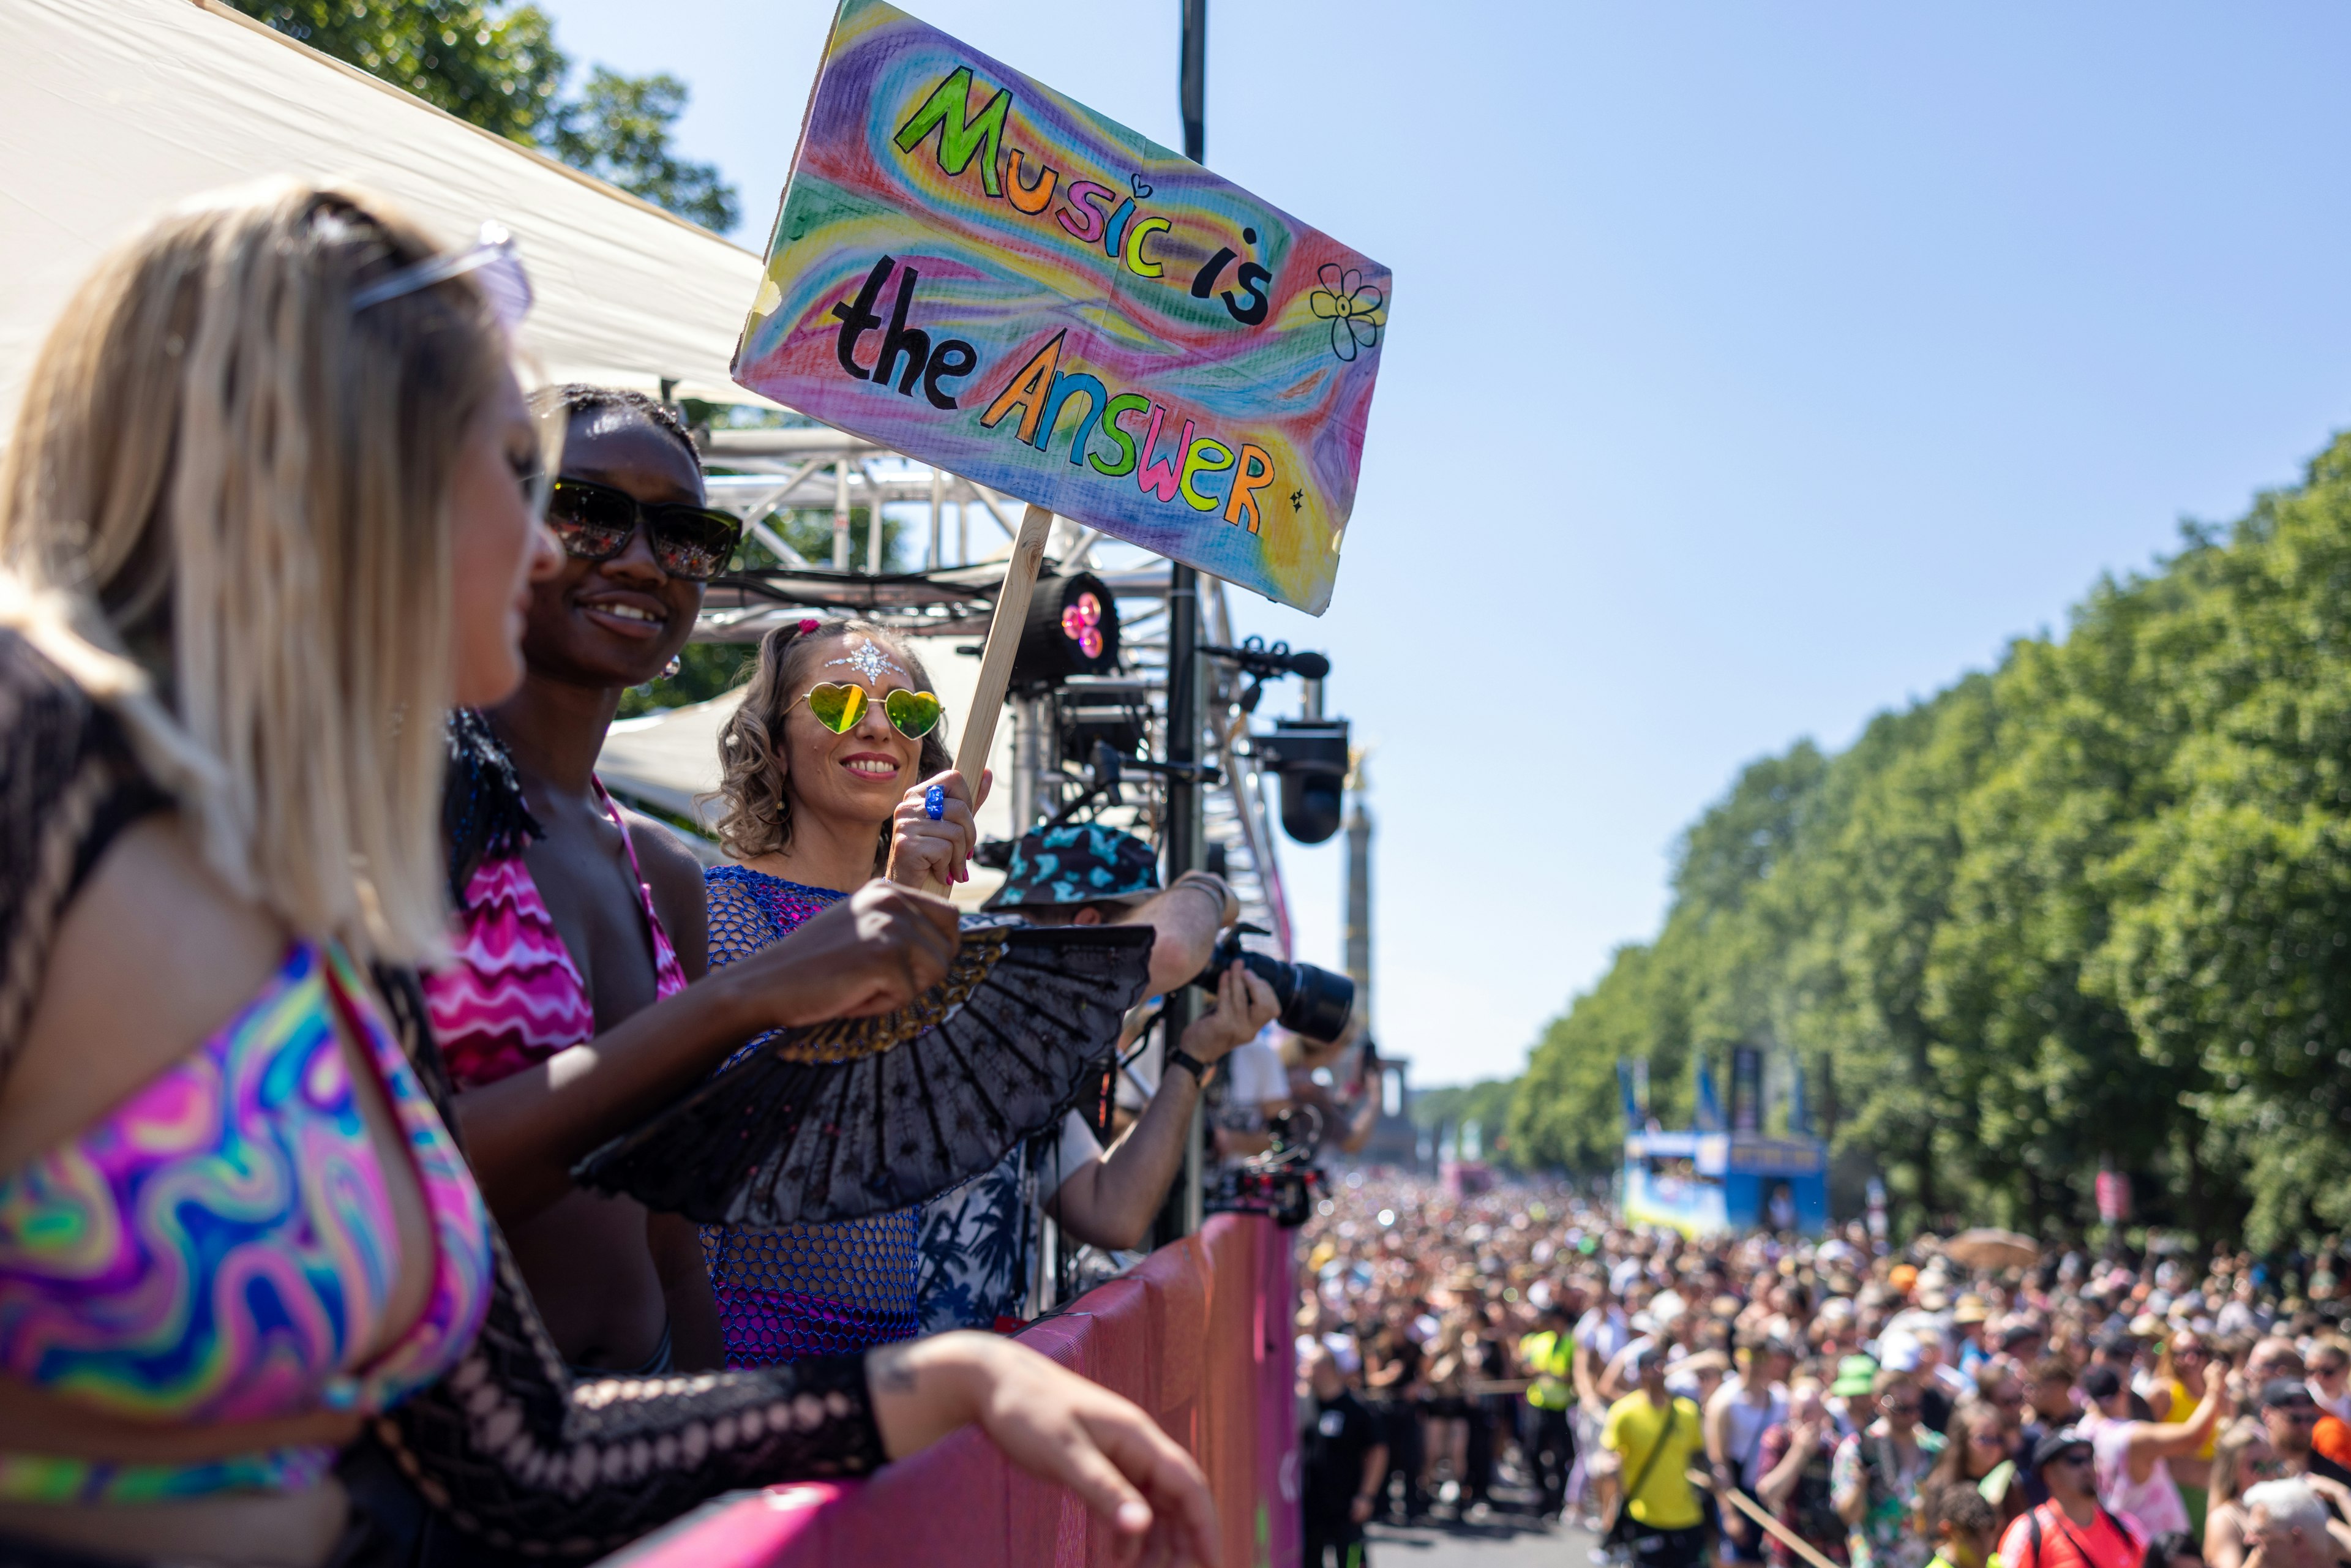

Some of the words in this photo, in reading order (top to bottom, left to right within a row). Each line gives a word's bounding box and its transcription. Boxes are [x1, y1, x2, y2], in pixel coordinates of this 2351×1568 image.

[894, 66, 1172, 279] Music
[1191, 227, 1272, 326] is
[831, 255, 977, 410] the
